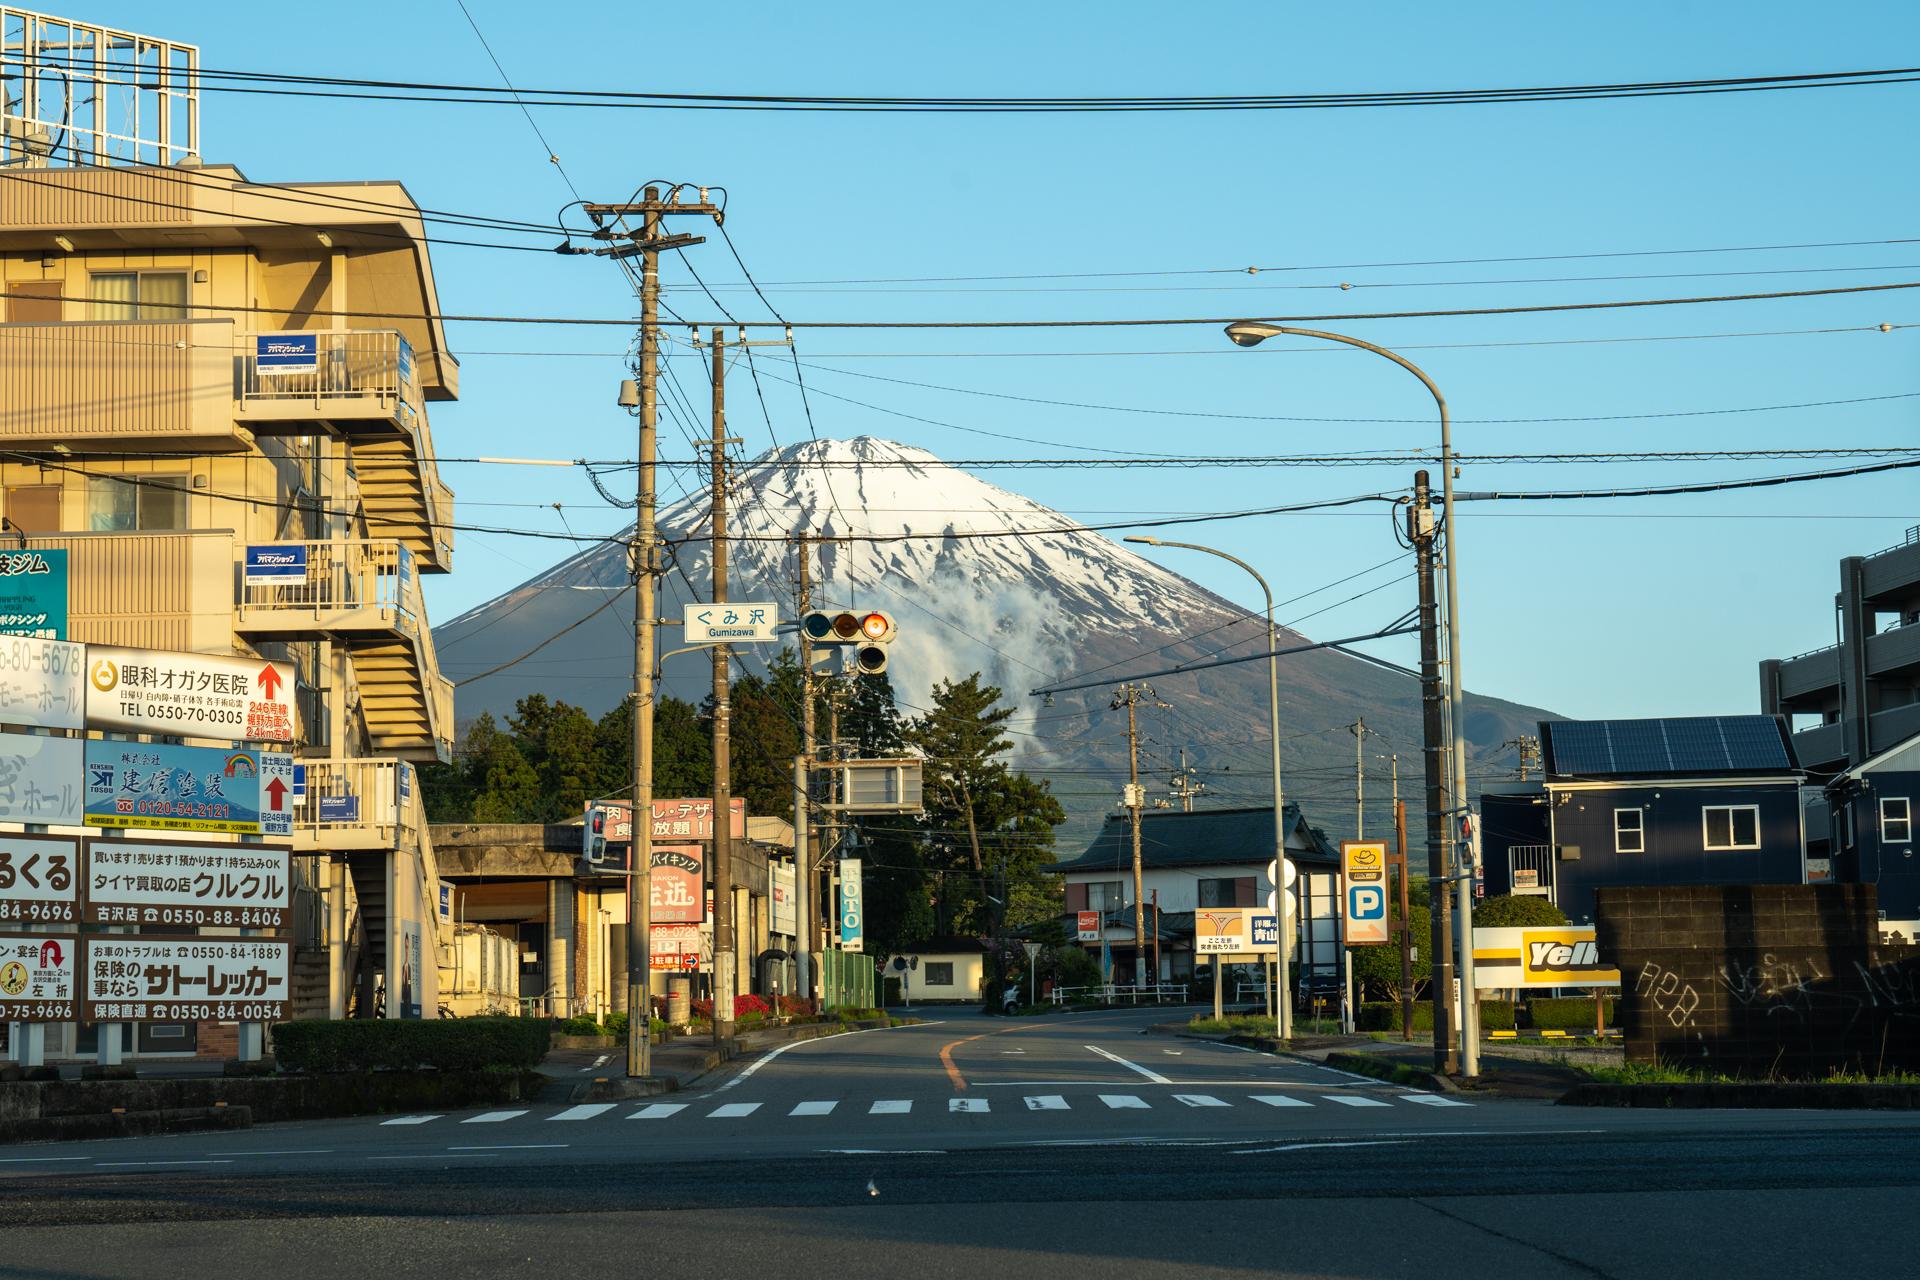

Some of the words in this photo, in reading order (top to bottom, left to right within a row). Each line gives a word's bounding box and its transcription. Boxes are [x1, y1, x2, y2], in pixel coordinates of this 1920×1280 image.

[257, 555, 296, 563] アパマンショップ
[697, 609, 766, 626] ぐみ沢
[709, 628, 755, 637] Gumizawa
[121, 665, 249, 696] 眼科オガタ医院
[120, 690, 143, 700] 日帰り
[120, 702, 142, 716] TEL
[147, 704, 243, 725] 0550-70-0305
[249, 701, 289, 716] 246号線
[246, 713, 292, 728] 裾野方面へ
[245, 726, 291, 742] 2.4km左側
[90, 763, 115, 771] KENSHIN
[120, 752, 161, 767] 株式会社
[261, 756, 293, 767] 富士岡公園
[262, 766, 293, 776] すぐそば
[90, 786, 114, 794] TOSOU
[119, 768, 226, 800] 建信塗装
[139, 800, 230, 819] 0120-54-2121
[261, 812, 293, 823] 旧246号線
[265, 823, 289, 833] 裾野方面
[843, 867, 860, 928] TOTO
[1355, 889, 1380, 918] P
[0, 904, 73, 921] 84-9696
[97, 906, 139, 922] 古沢店
[163, 908, 281, 926] 0550-88-8406
[1254, 928, 1277, 941] 青山
[93, 946, 171, 958] お車のトラブルは
[191, 946, 281, 959] 0550-84-1889
[1530, 942, 1599, 966] Yell
[93, 960, 141, 978] 保険の
[93, 979, 139, 997] 事なら
[143, 964, 283, 997] サトーレッカー
[32, 984, 68, 998] 左折
[94, 1003, 147, 1019] 保険直通
[170, 1004, 282, 1019] 0550-84-0054
